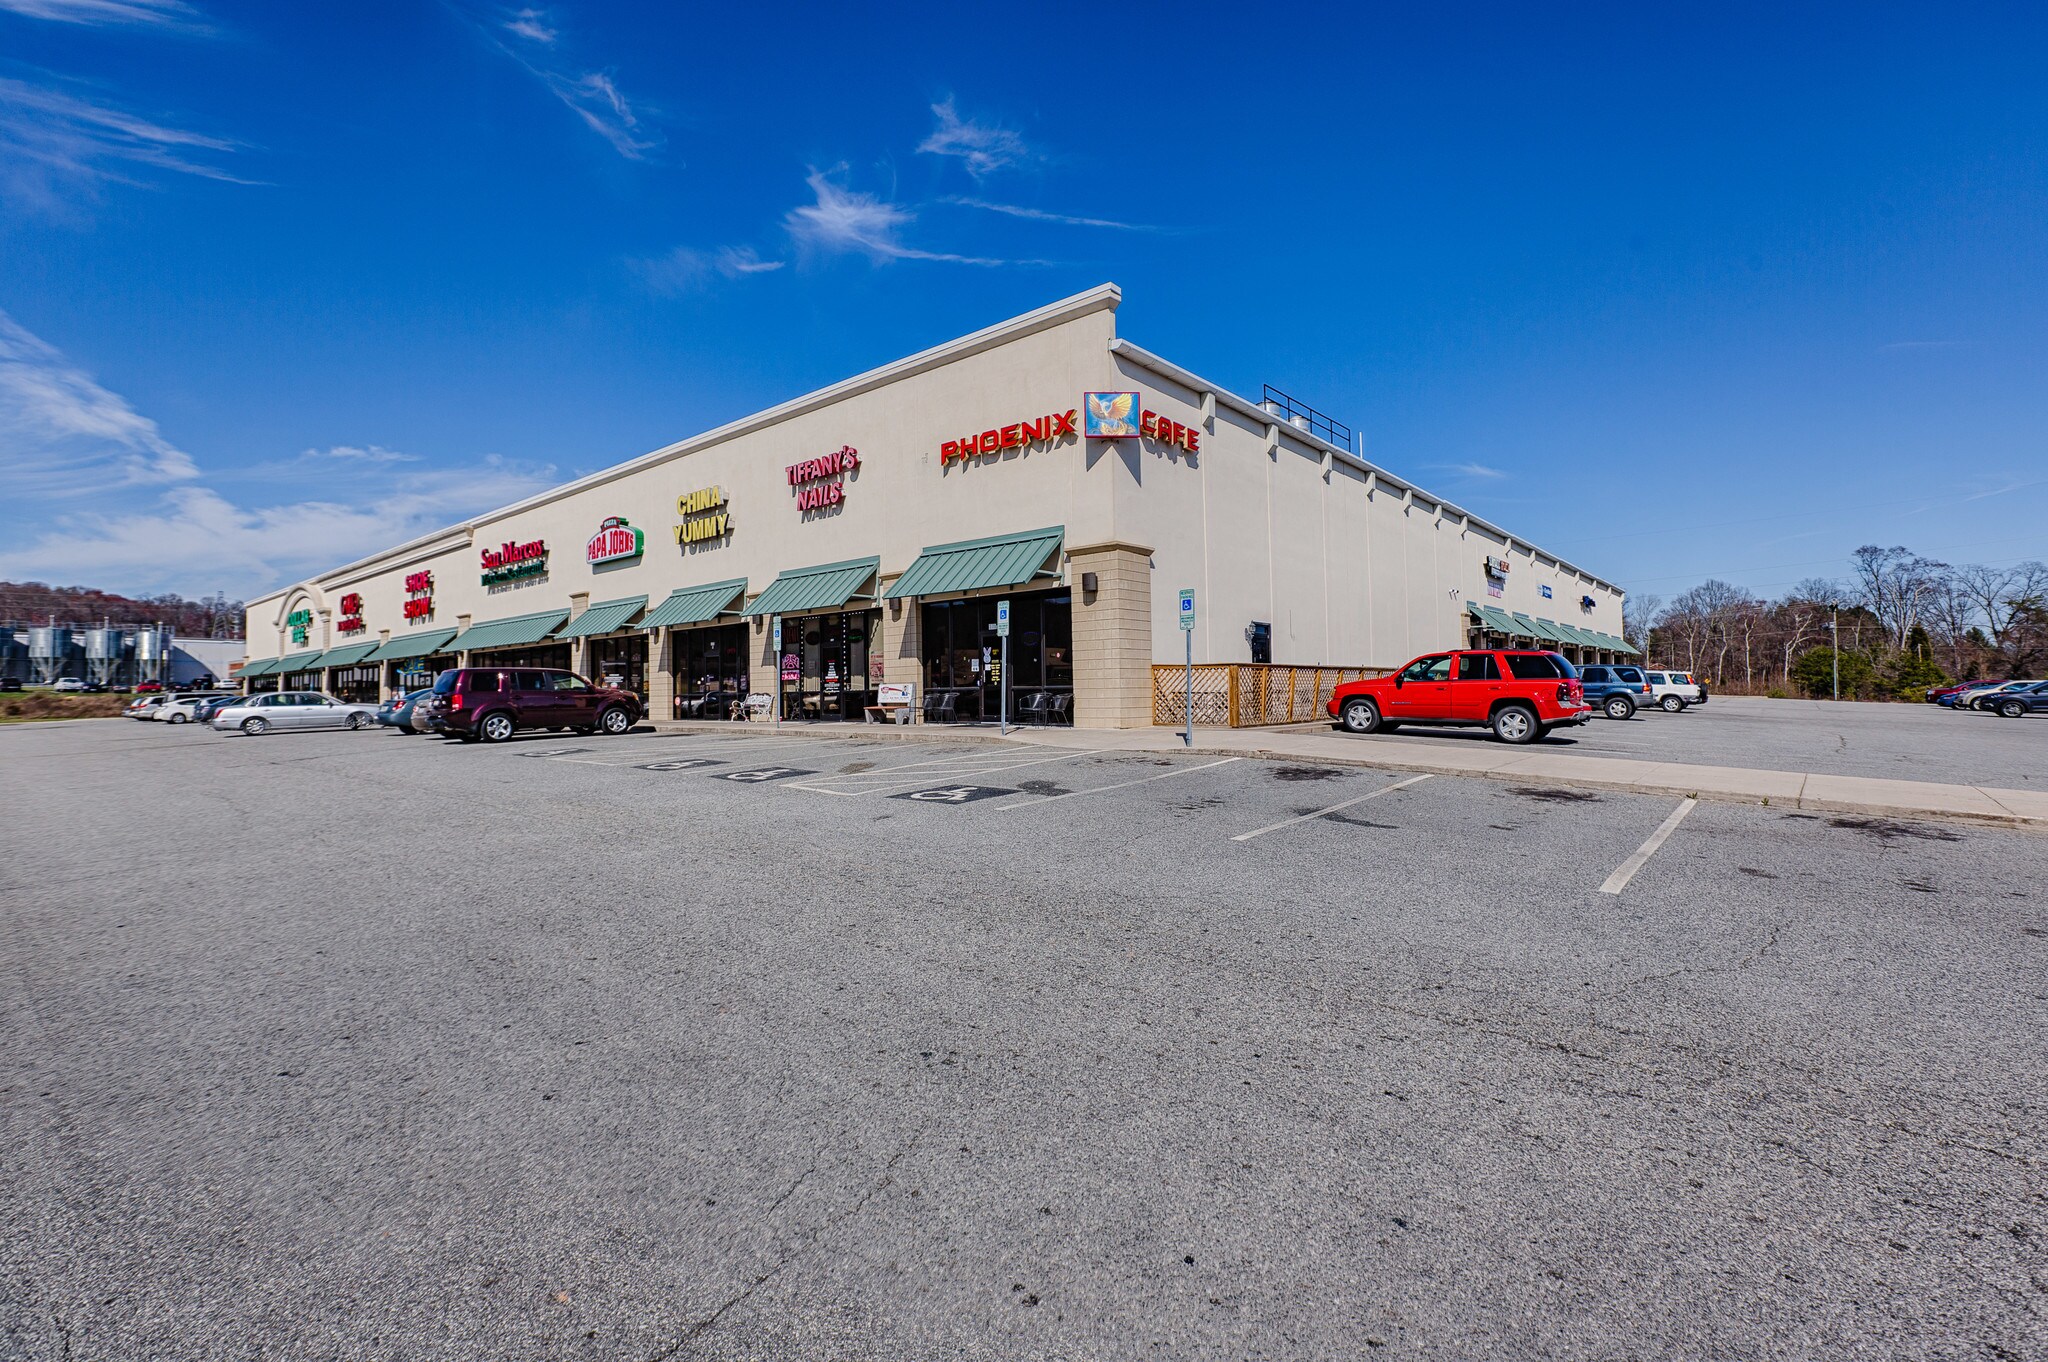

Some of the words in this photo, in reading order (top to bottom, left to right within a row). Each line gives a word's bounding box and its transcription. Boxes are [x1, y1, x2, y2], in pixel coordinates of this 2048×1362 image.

[940, 408, 1077, 467] PHOENIX
[1141, 408, 1200, 452] CAFE
[785, 445, 859, 486] TIFFANY'S
[677, 485, 723, 516] CHINA
[797, 482, 843, 512] NAILS
[672, 513, 730, 545] YUMMY
[481, 548, 501, 569] San
[502, 540, 545, 564] Marcos
[587, 533, 607, 561] PAPA
[405, 570, 431, 593] SHOE
[403, 597, 431, 619] SHOW
